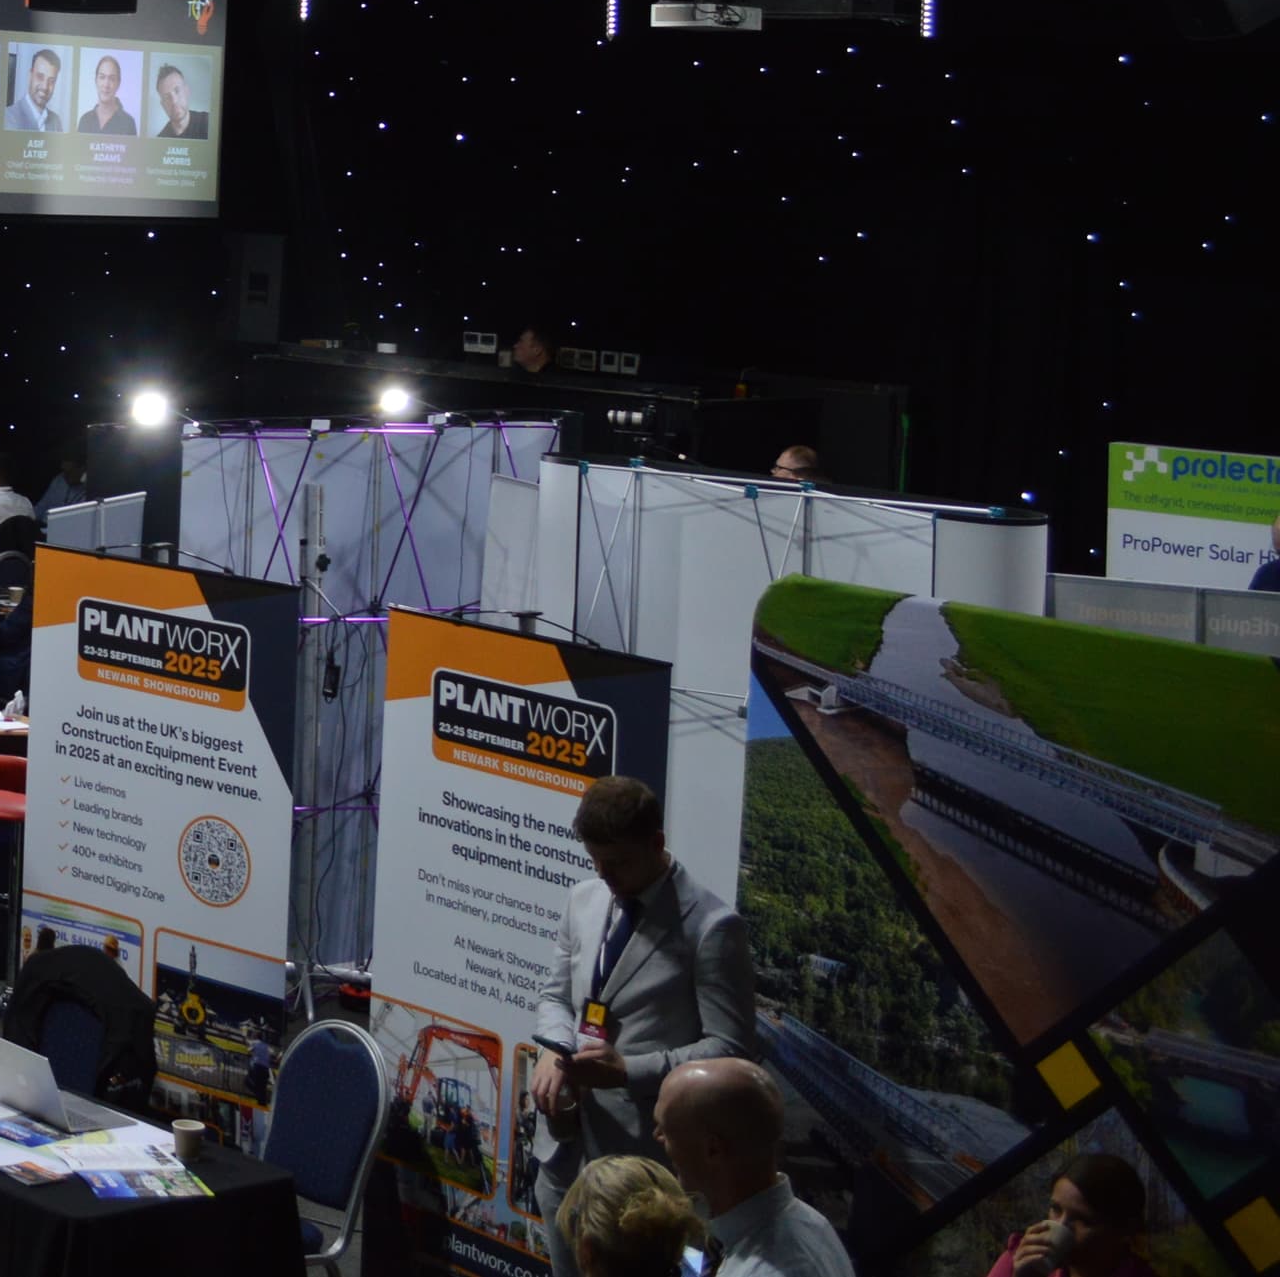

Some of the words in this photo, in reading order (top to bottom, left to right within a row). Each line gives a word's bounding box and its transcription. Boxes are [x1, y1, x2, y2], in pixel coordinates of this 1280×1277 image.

[1123, 490, 1141, 501] The
[1123, 534, 1204, 558] ProPower
[1209, 544, 1253, 564] Solar
[84, 607, 241, 671] PLANTWORX
[83, 645, 109, 658] 23-25
[110, 651, 163, 669] SEPTEMBER
[164, 651, 222, 680] 2025
[97, 668, 140, 685] NEWARK
[143, 678, 220, 702] SHOWGROUND
[76, 705, 103, 721] Join
[106, 713, 120, 725] us
[122, 716, 135, 729] at
[138, 718, 158, 734] the
[160, 723, 189, 741] UK's
[192, 729, 243, 754] biggest
[439, 679, 607, 757] PLANTWORX
[61, 722, 143, 752] Construction
[145, 741, 215, 769] Equipment
[218, 757, 257, 778] Event
[439, 722, 465, 737] 23-25
[466, 728, 525, 752] SEPTEMBER
[526, 731, 588, 767] 2025
[55, 741, 67, 755] in
[69, 743, 100, 762] 2025
[102, 753, 115, 767] at
[117, 757, 132, 770] an
[134, 761, 183, 786] exciting
[186, 774, 214, 790] new
[217, 780, 262, 802] venue.
[74, 776, 93, 790] Live
[95, 782, 126, 799] demos
[453, 748, 500, 770] NEWARK
[503, 760, 585, 792] SHOWGROUND
[74, 799, 110, 819] Leading
[112, 808, 143, 826] brands
[418, 807, 492, 841] innovations
[495, 828, 507, 845] in
[510, 833, 532, 852] the
[442, 790, 520, 829] Showcasing
[523, 813, 545, 832] the
[73, 821, 95, 836] New
[96, 828, 147, 852] technology
[72, 845, 96, 858] 400+
[98, 853, 143, 872] exhibitors
[452, 842, 522, 871] equipment
[71, 867, 105, 884] Shared
[106, 876, 141, 897] Digging
[142, 886, 165, 902] Zone
[418, 868, 446, 887] Don't
[448, 879, 470, 894] miss
[472, 886, 494, 901] your
[496, 892, 532, 913] chance
[534, 904, 545, 917] to
[425, 890, 435, 903] in
[437, 895, 489, 922] machinery,
[492, 912, 537, 935] products
[539, 928, 558, 942] and
[454, 935, 465, 949] At
[467, 939, 504, 962] Newark
[414, 961, 457, 985] (Located
[458, 978, 469, 990] at
[470, 979, 487, 995] the
[489, 986, 502, 1004] A1,
[504, 992, 525, 1009] A46
[466, 958, 505, 984] Newark,
[508, 972, 536, 992] NG24
